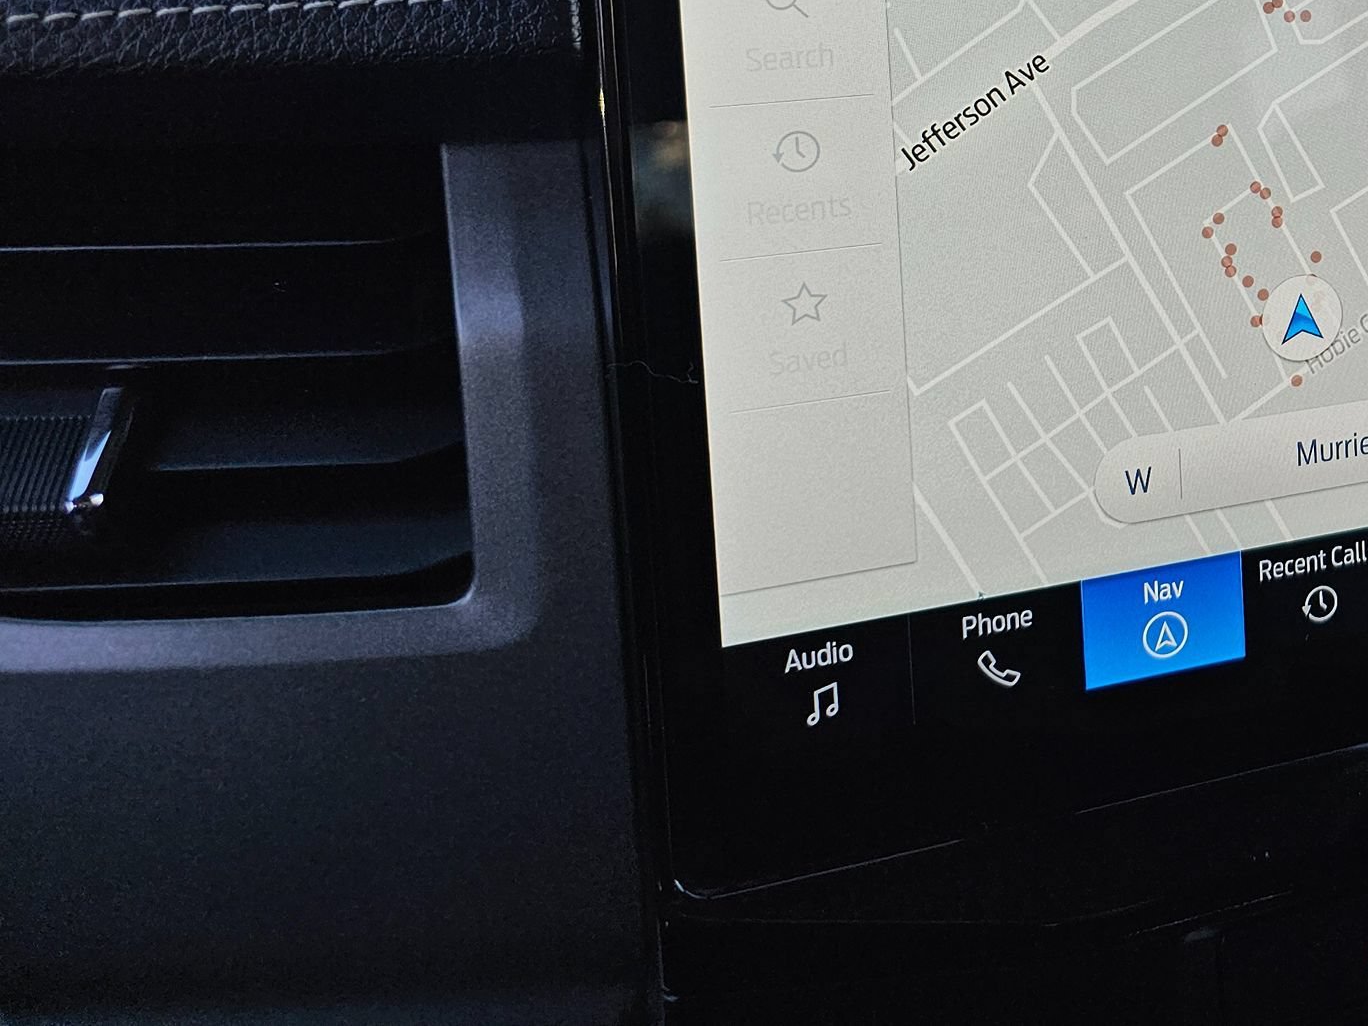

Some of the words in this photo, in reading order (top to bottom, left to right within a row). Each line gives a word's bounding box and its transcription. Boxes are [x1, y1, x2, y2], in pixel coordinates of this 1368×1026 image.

[745, 45, 834, 73] Search
[900, 85, 1006, 171] Jefferson
[1004, 52, 1051, 98] Ave
[747, 193, 852, 226] Recents
[768, 342, 848, 376] Saved
[1124, 466, 1152, 496] W
[1258, 549, 1327, 582] Recent
[1143, 579, 1184, 605] Nav
[961, 607, 1033, 639] Phone
[784, 640, 854, 674] Audio
